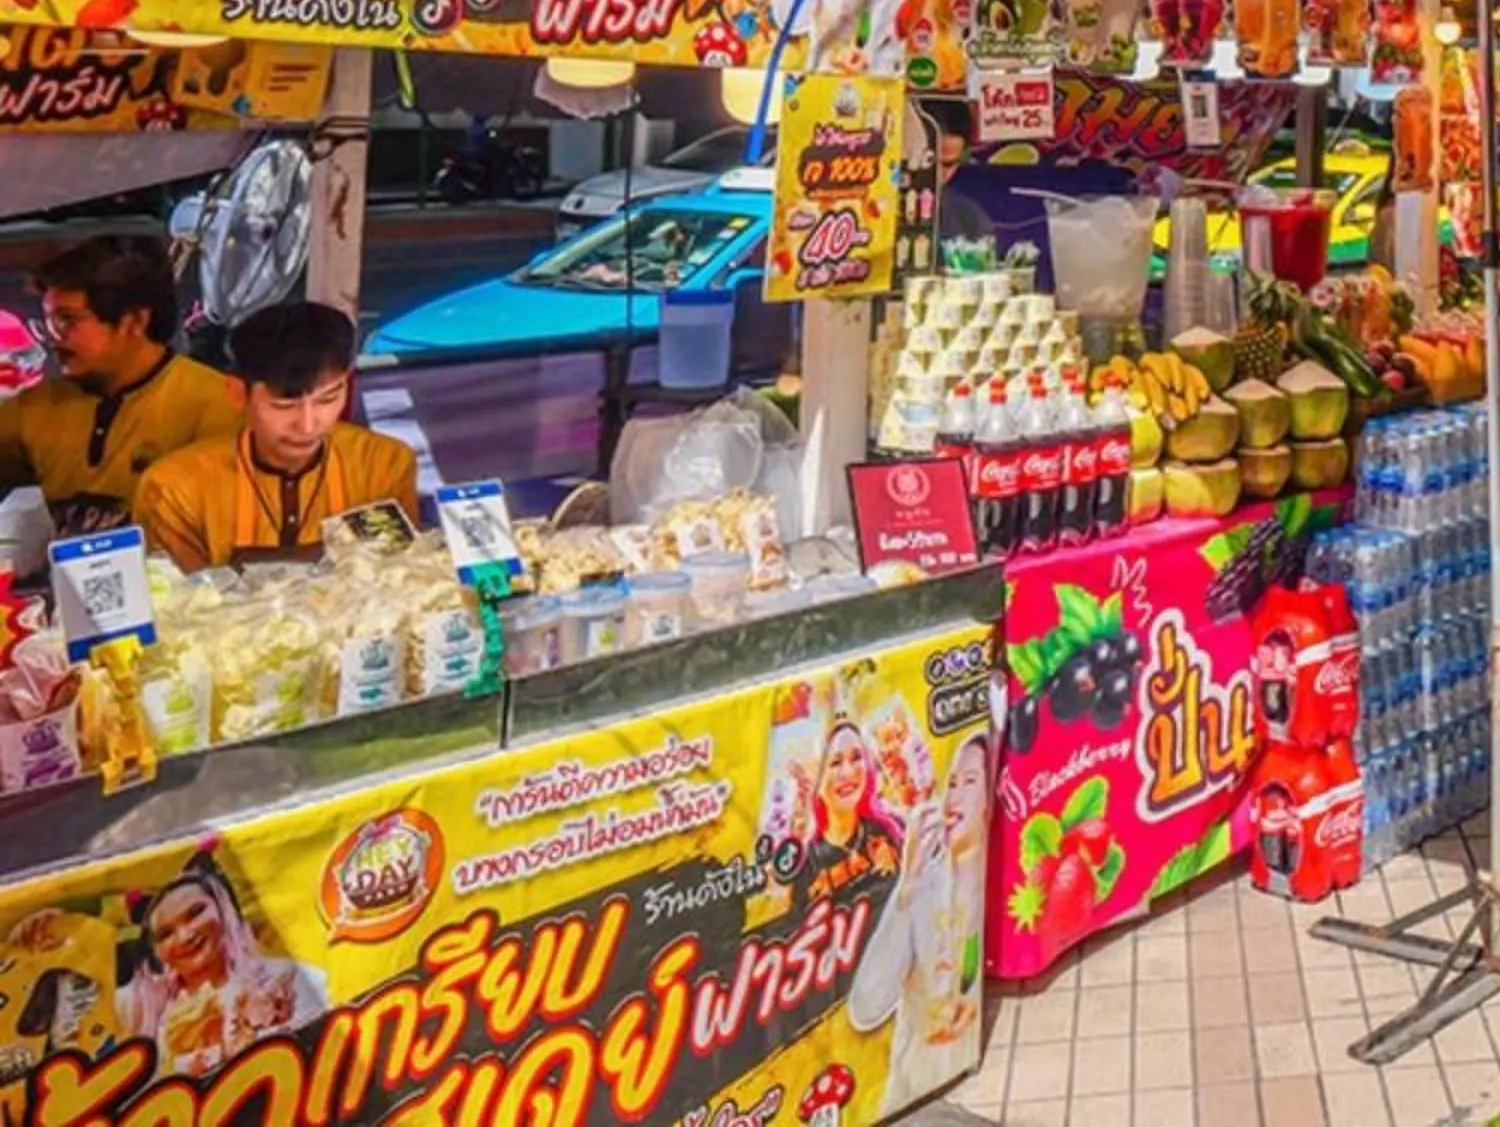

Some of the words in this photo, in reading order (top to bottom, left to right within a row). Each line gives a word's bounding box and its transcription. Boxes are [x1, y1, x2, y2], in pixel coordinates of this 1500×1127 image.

[643, 855, 765, 924] ร้านดังใน
[692, 894, 870, 1053] ฟาร์ม
